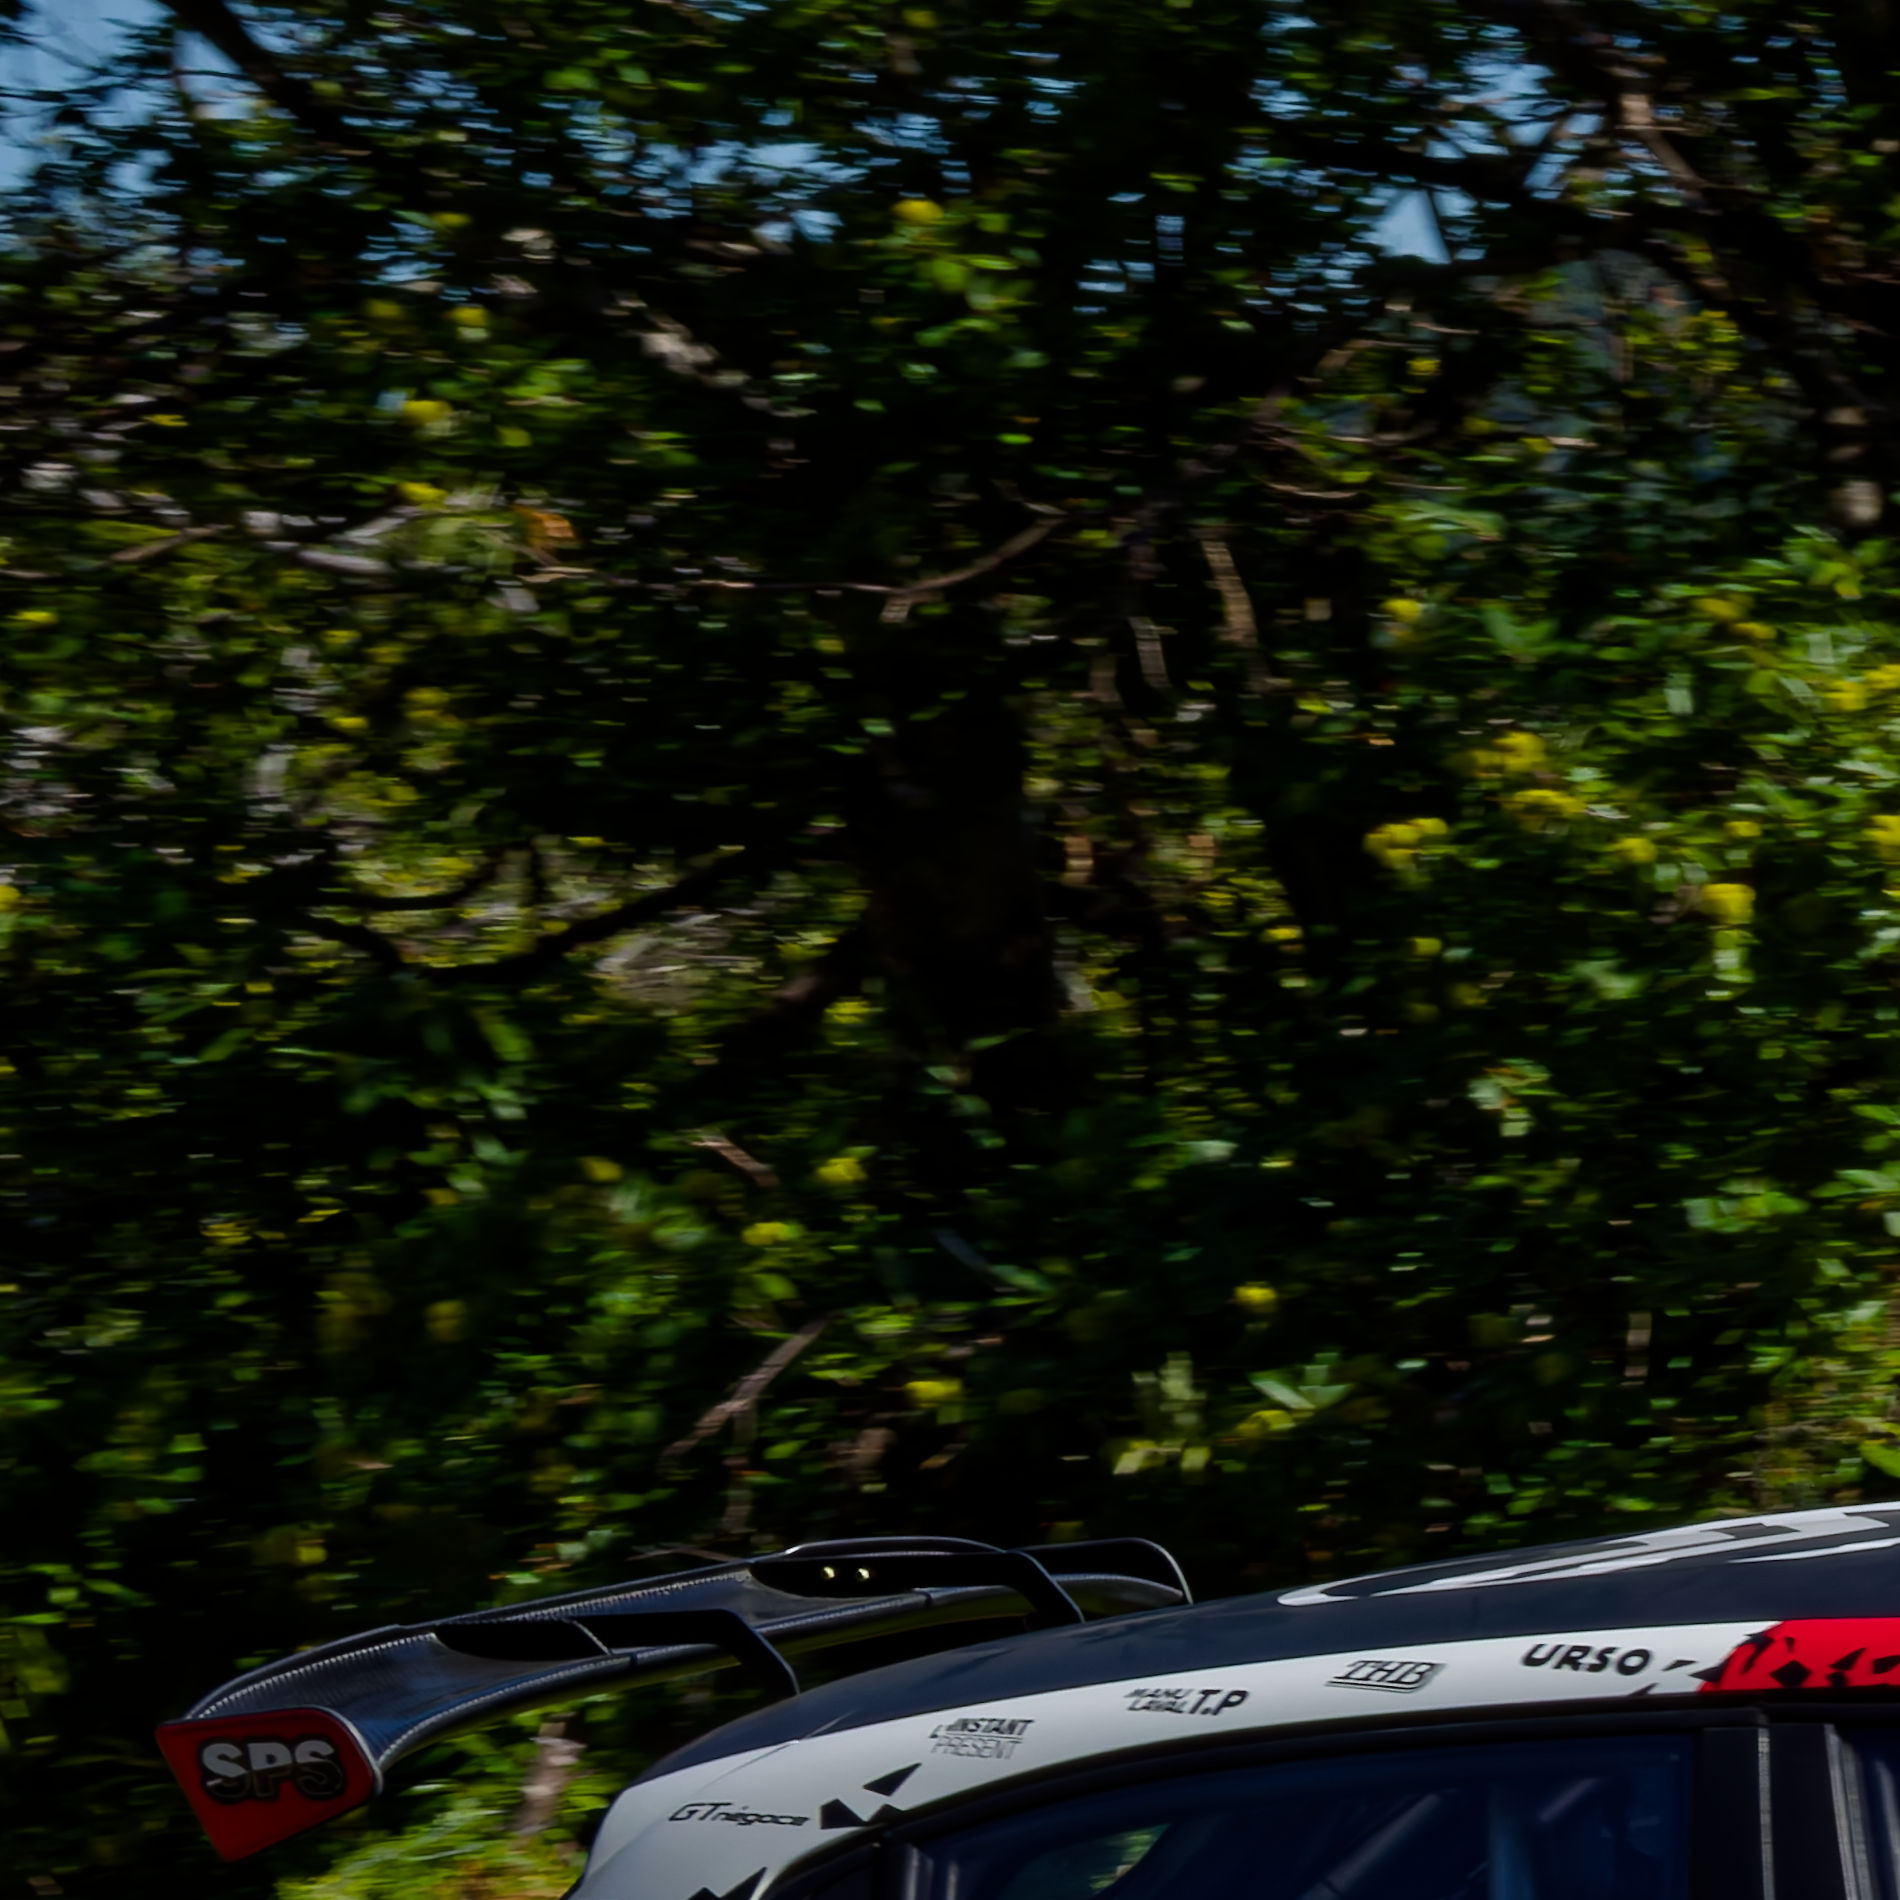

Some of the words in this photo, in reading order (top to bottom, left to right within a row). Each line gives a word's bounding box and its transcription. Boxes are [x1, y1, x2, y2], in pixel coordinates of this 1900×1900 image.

[1333, 1659, 1436, 1686] THB
[1521, 1643, 1653, 1676] URSO
[1188, 1689, 1249, 1716] T.P
[930, 1735, 1023, 1760] PRESENT
[202, 1739, 345, 1801] SPS
